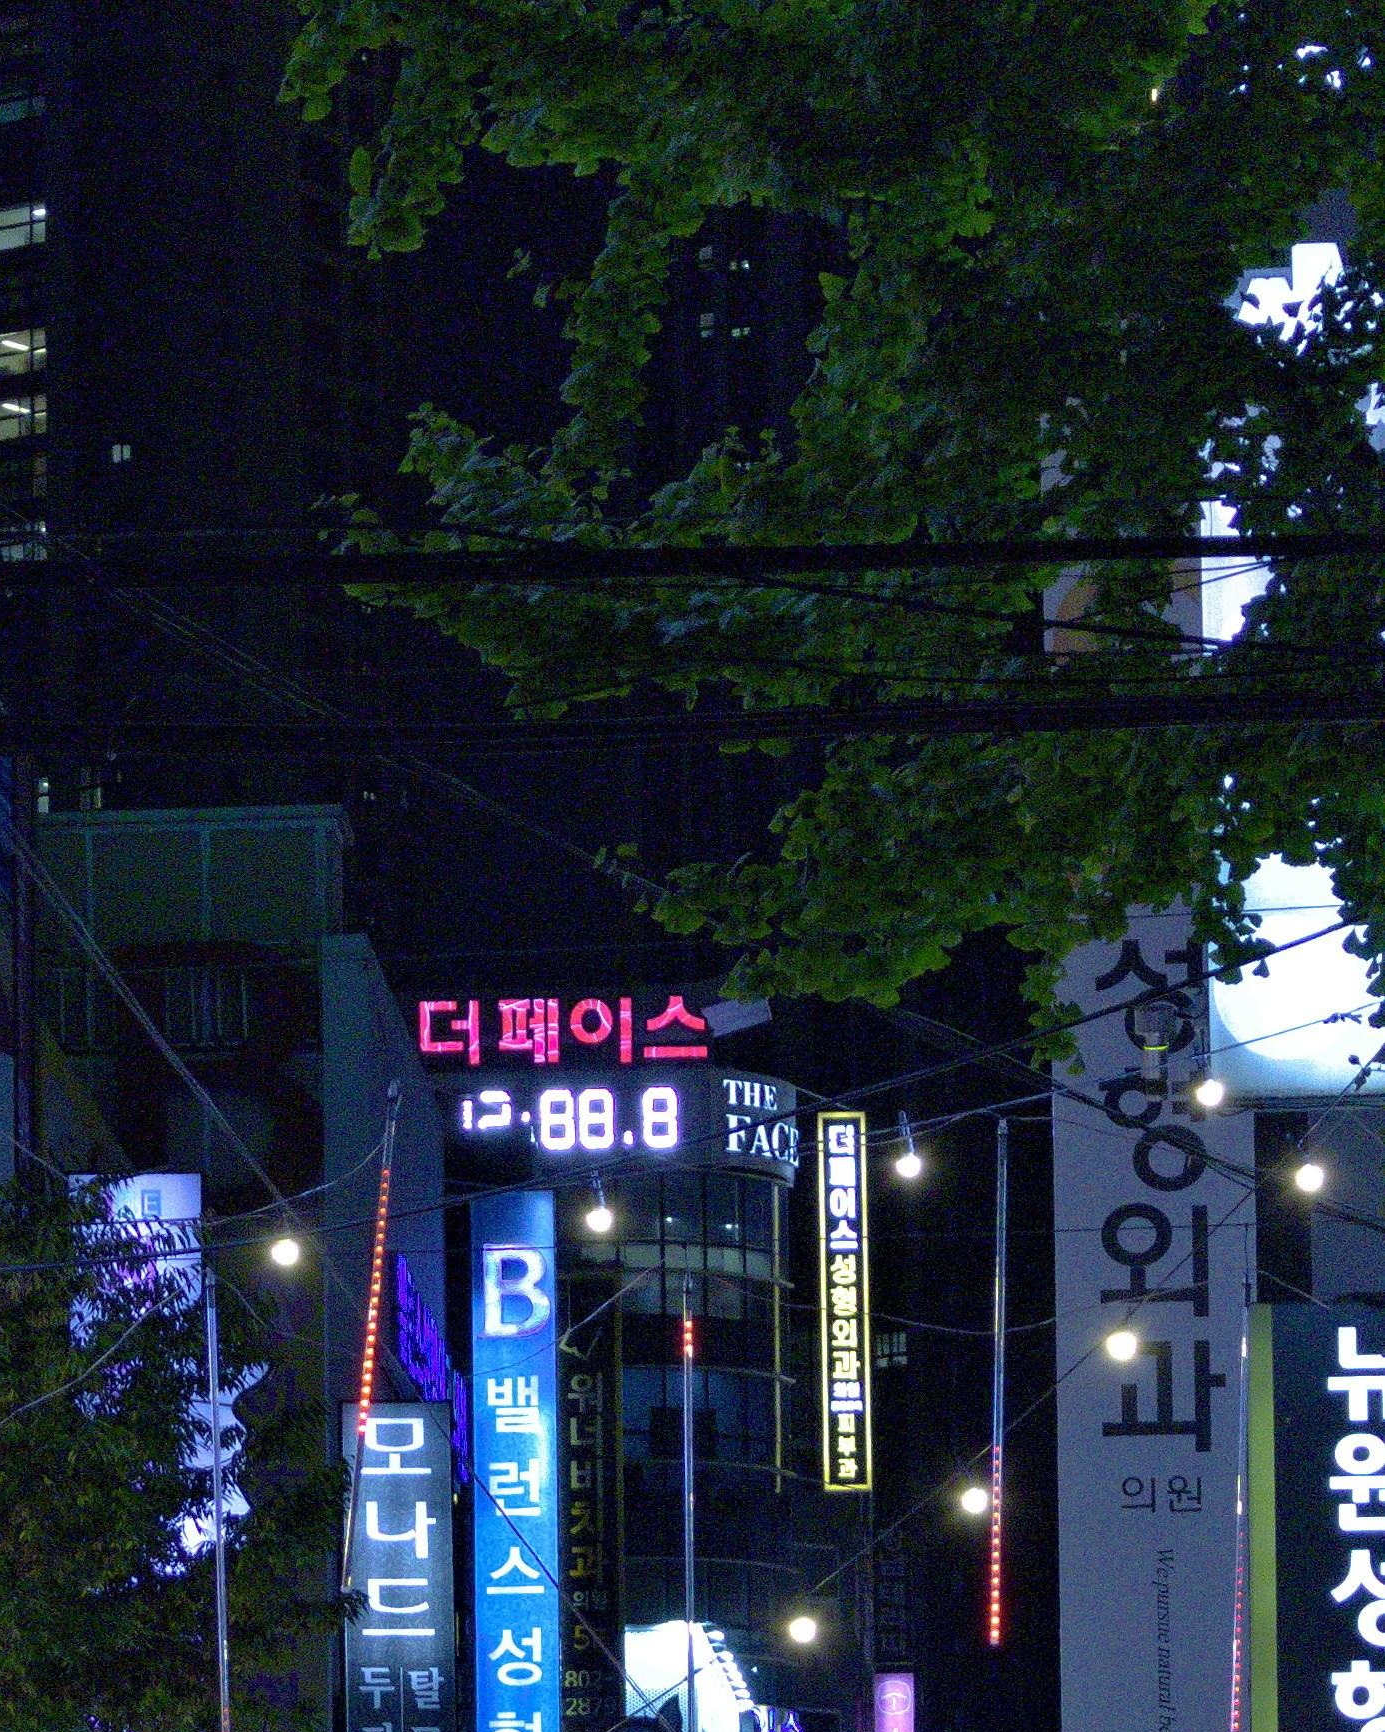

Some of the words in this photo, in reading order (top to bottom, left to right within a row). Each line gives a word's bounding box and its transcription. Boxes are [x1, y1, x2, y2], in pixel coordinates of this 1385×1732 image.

[723, 1078, 778, 1110] THE
[725, 1113, 801, 1168] FACE
[478, 1243, 553, 1340] B
[1121, 1476, 1203, 1514] 의원
[360, 1417, 439, 1638] 모나드
